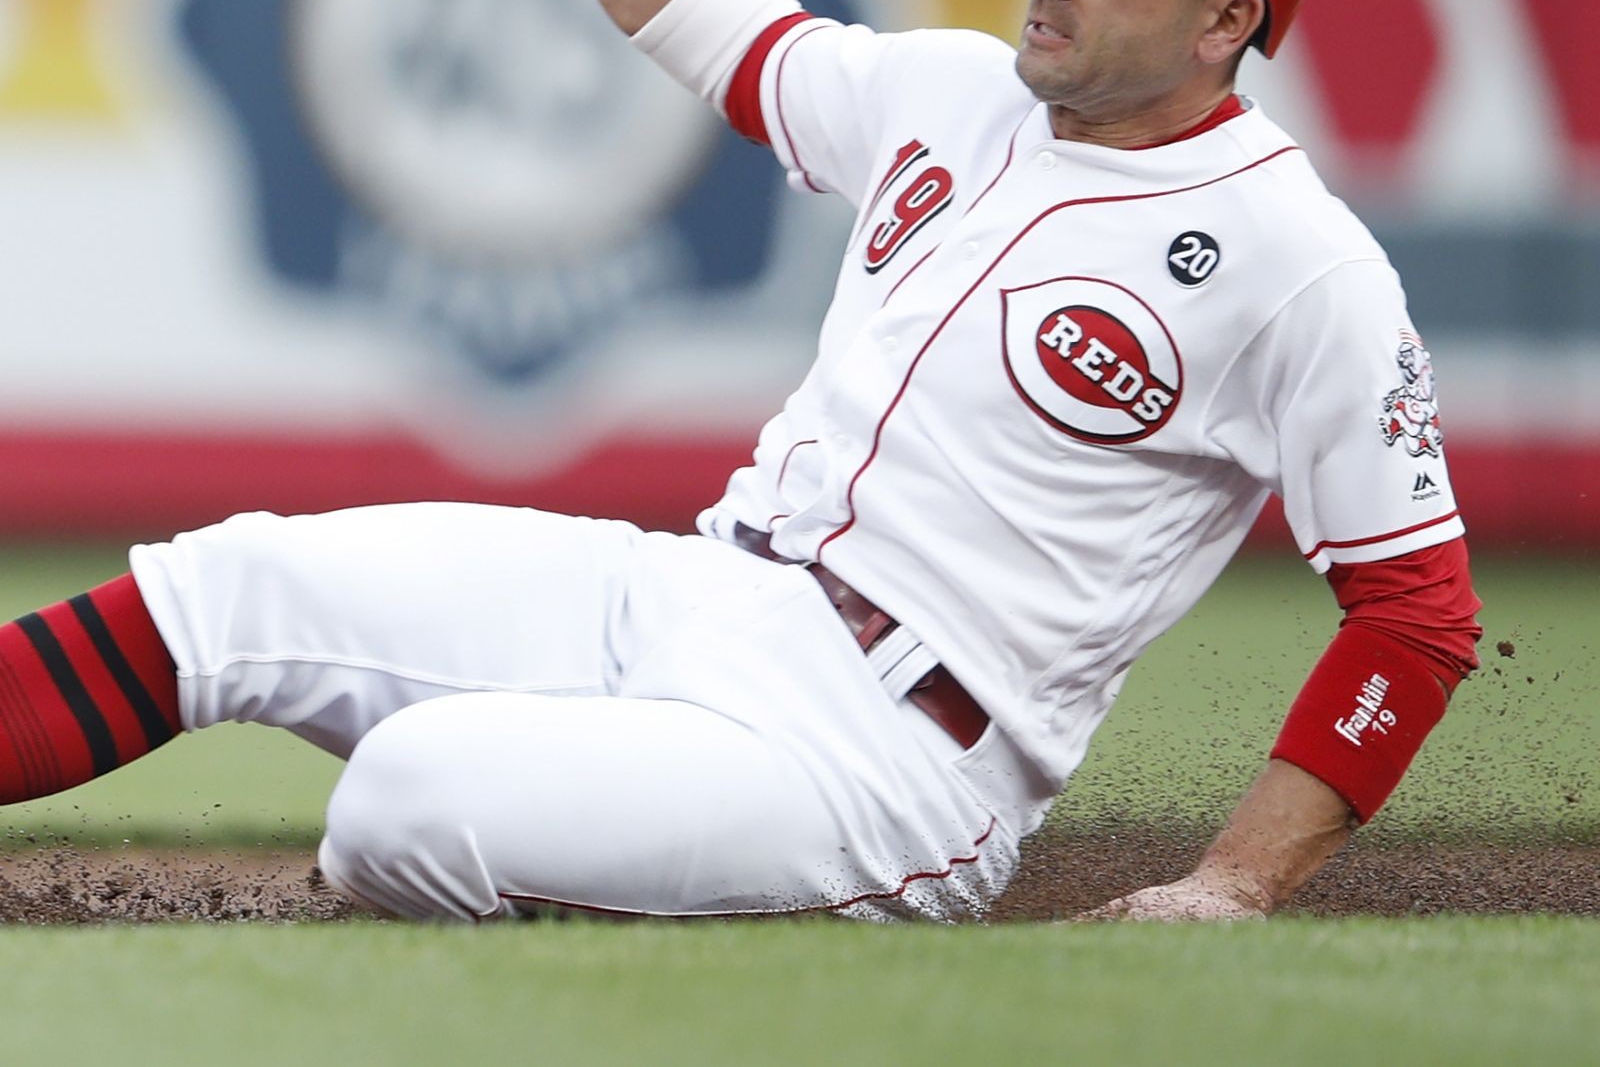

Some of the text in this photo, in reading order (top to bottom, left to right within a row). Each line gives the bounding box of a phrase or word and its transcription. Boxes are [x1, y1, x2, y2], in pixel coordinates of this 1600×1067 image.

[850, 138, 956, 275] 19
[1168, 235, 1218, 279] 20
[1039, 313, 1175, 422] REDS
[1371, 709, 1397, 735] 19
